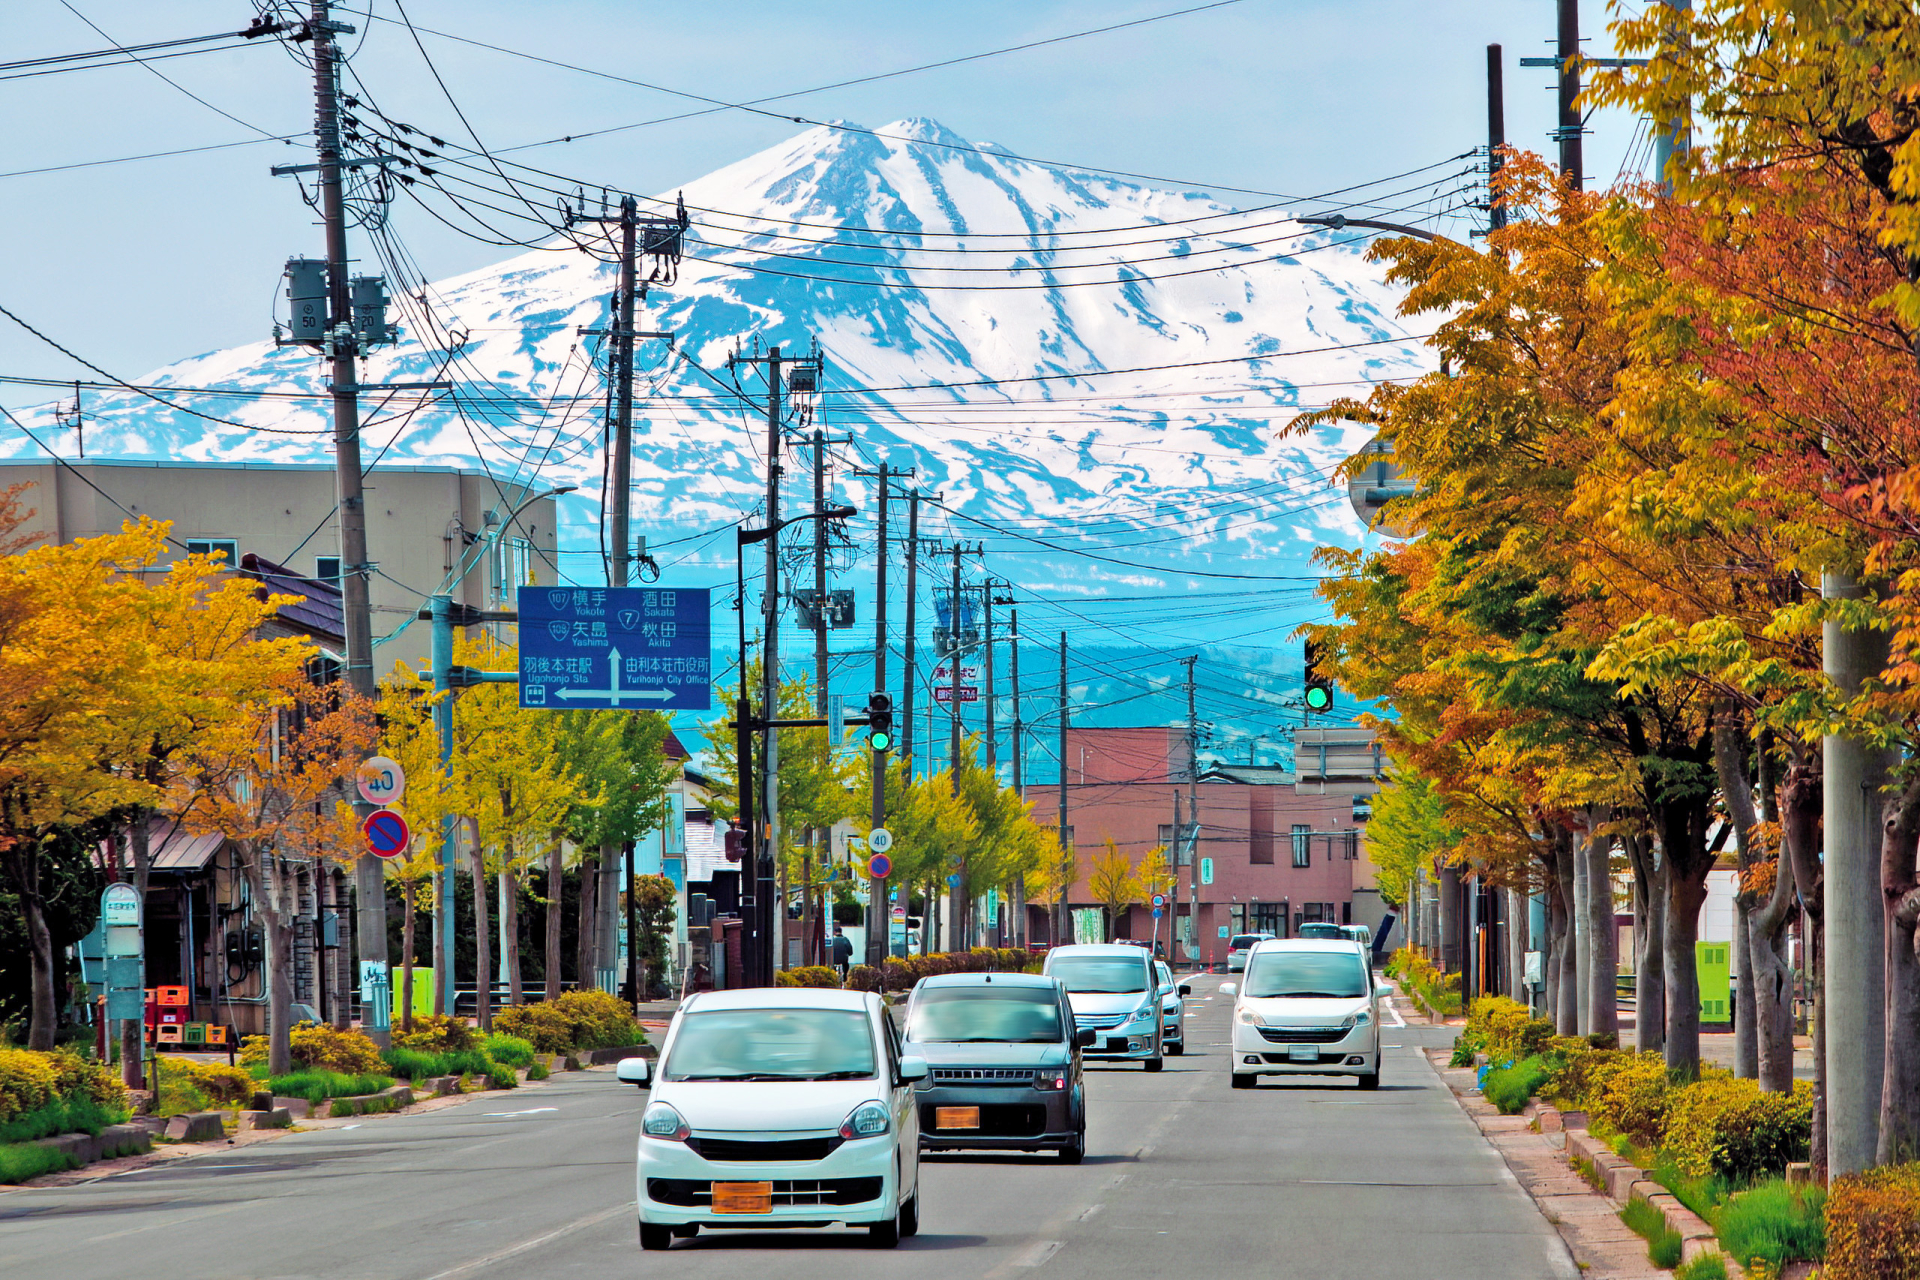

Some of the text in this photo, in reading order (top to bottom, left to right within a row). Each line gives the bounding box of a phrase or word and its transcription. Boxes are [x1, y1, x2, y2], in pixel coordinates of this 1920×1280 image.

[302, 316, 316, 328] 50
[551, 593, 567, 603] 107
[572, 589, 607, 607] 横手
[642, 591, 676, 607] 酒田
[575, 607, 605, 616] Yokote
[644, 608, 675, 617] Sakata
[624, 612, 633, 625] 7
[572, 621, 607, 638] 矢島
[641, 621, 676, 638] 秋田
[572, 637, 609, 647] Yashima
[648, 638, 671, 648] Akita
[523, 656, 593, 674] 羽後本荘駅
[625, 656, 709, 673] 由利本荘市役所
[527, 673, 570, 685] Ugohonjo
[626, 674, 709, 686] Yurihonjo City Office
[368, 770, 394, 791] 40
[874, 835, 887, 846] 40
